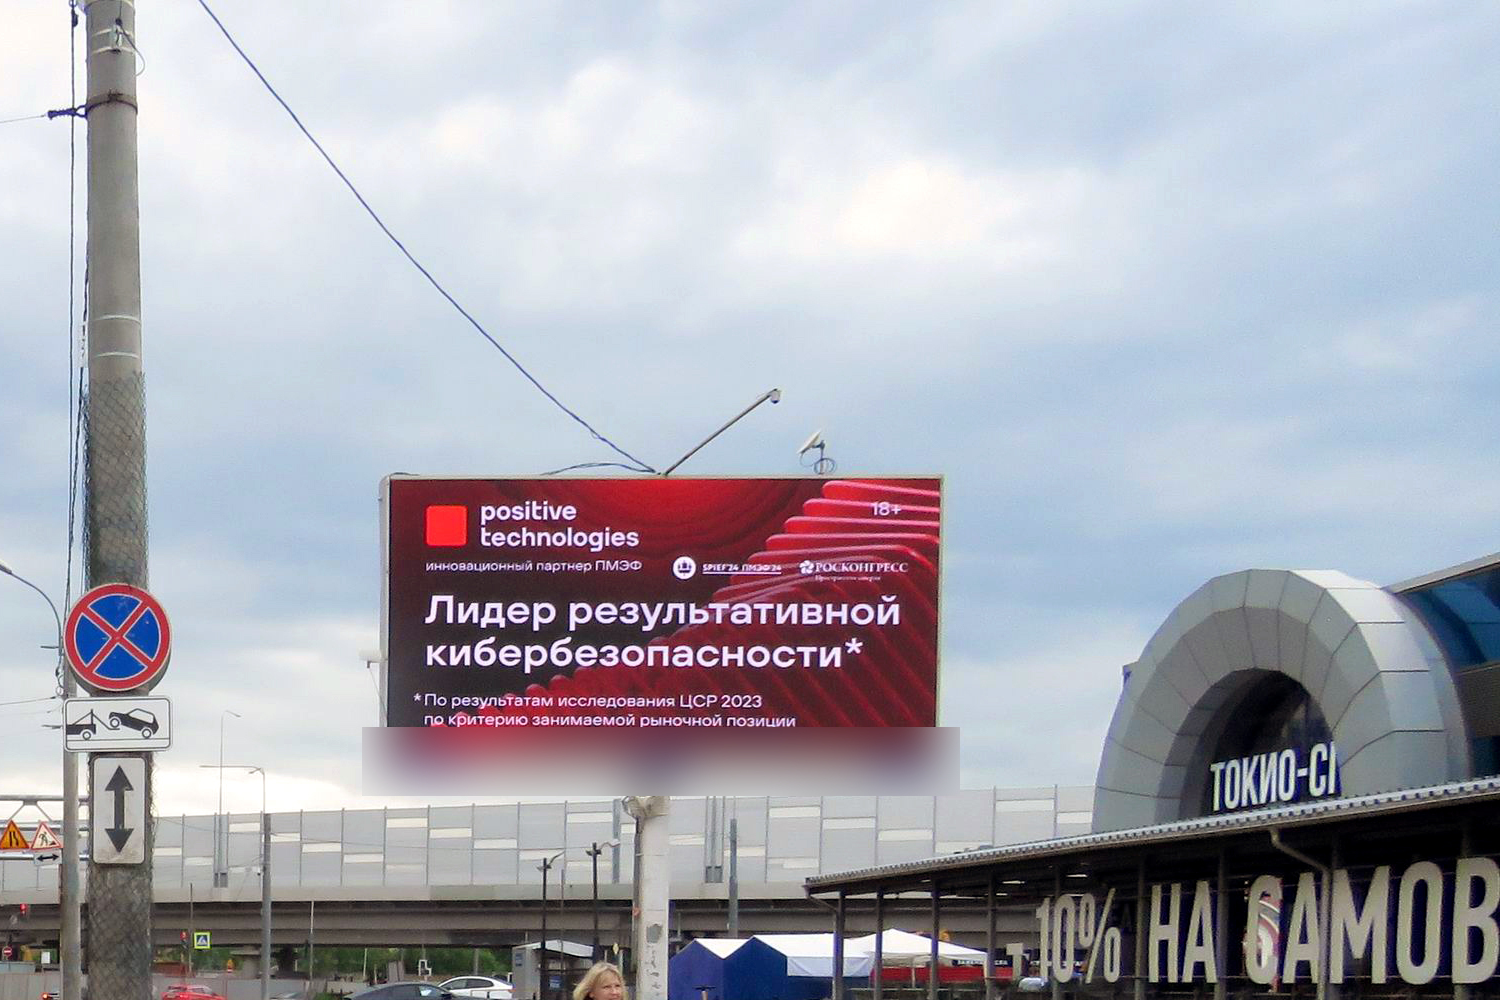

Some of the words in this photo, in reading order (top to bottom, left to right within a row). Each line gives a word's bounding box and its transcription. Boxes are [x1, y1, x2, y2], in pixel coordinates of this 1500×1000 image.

[480, 500, 577, 525] positive
[872, 502, 902, 516] 18+
[480, 526, 639, 552] technologies
[425, 560, 533, 573] инновационный
[536, 562, 592, 574] партнер
[595, 560, 642, 572] ПМЭФ
[815, 561, 909, 574] РОСКОНГРЕСС
[425, 594, 557, 632] Лидер
[568, 594, 901, 632] результативной
[451, 696, 554, 710] результатам
[557, 697, 676, 709] исследования
[678, 694, 718, 710] ЦСР
[721, 694, 763, 709] 2023
[424, 715, 444, 727] по
[448, 715, 528, 727] критерию
[531, 714, 636, 727] занимаемой
[639, 714, 723, 727] рыночной
[726, 716, 797, 727] позиции
[1148, 880, 1218, 983] НА
